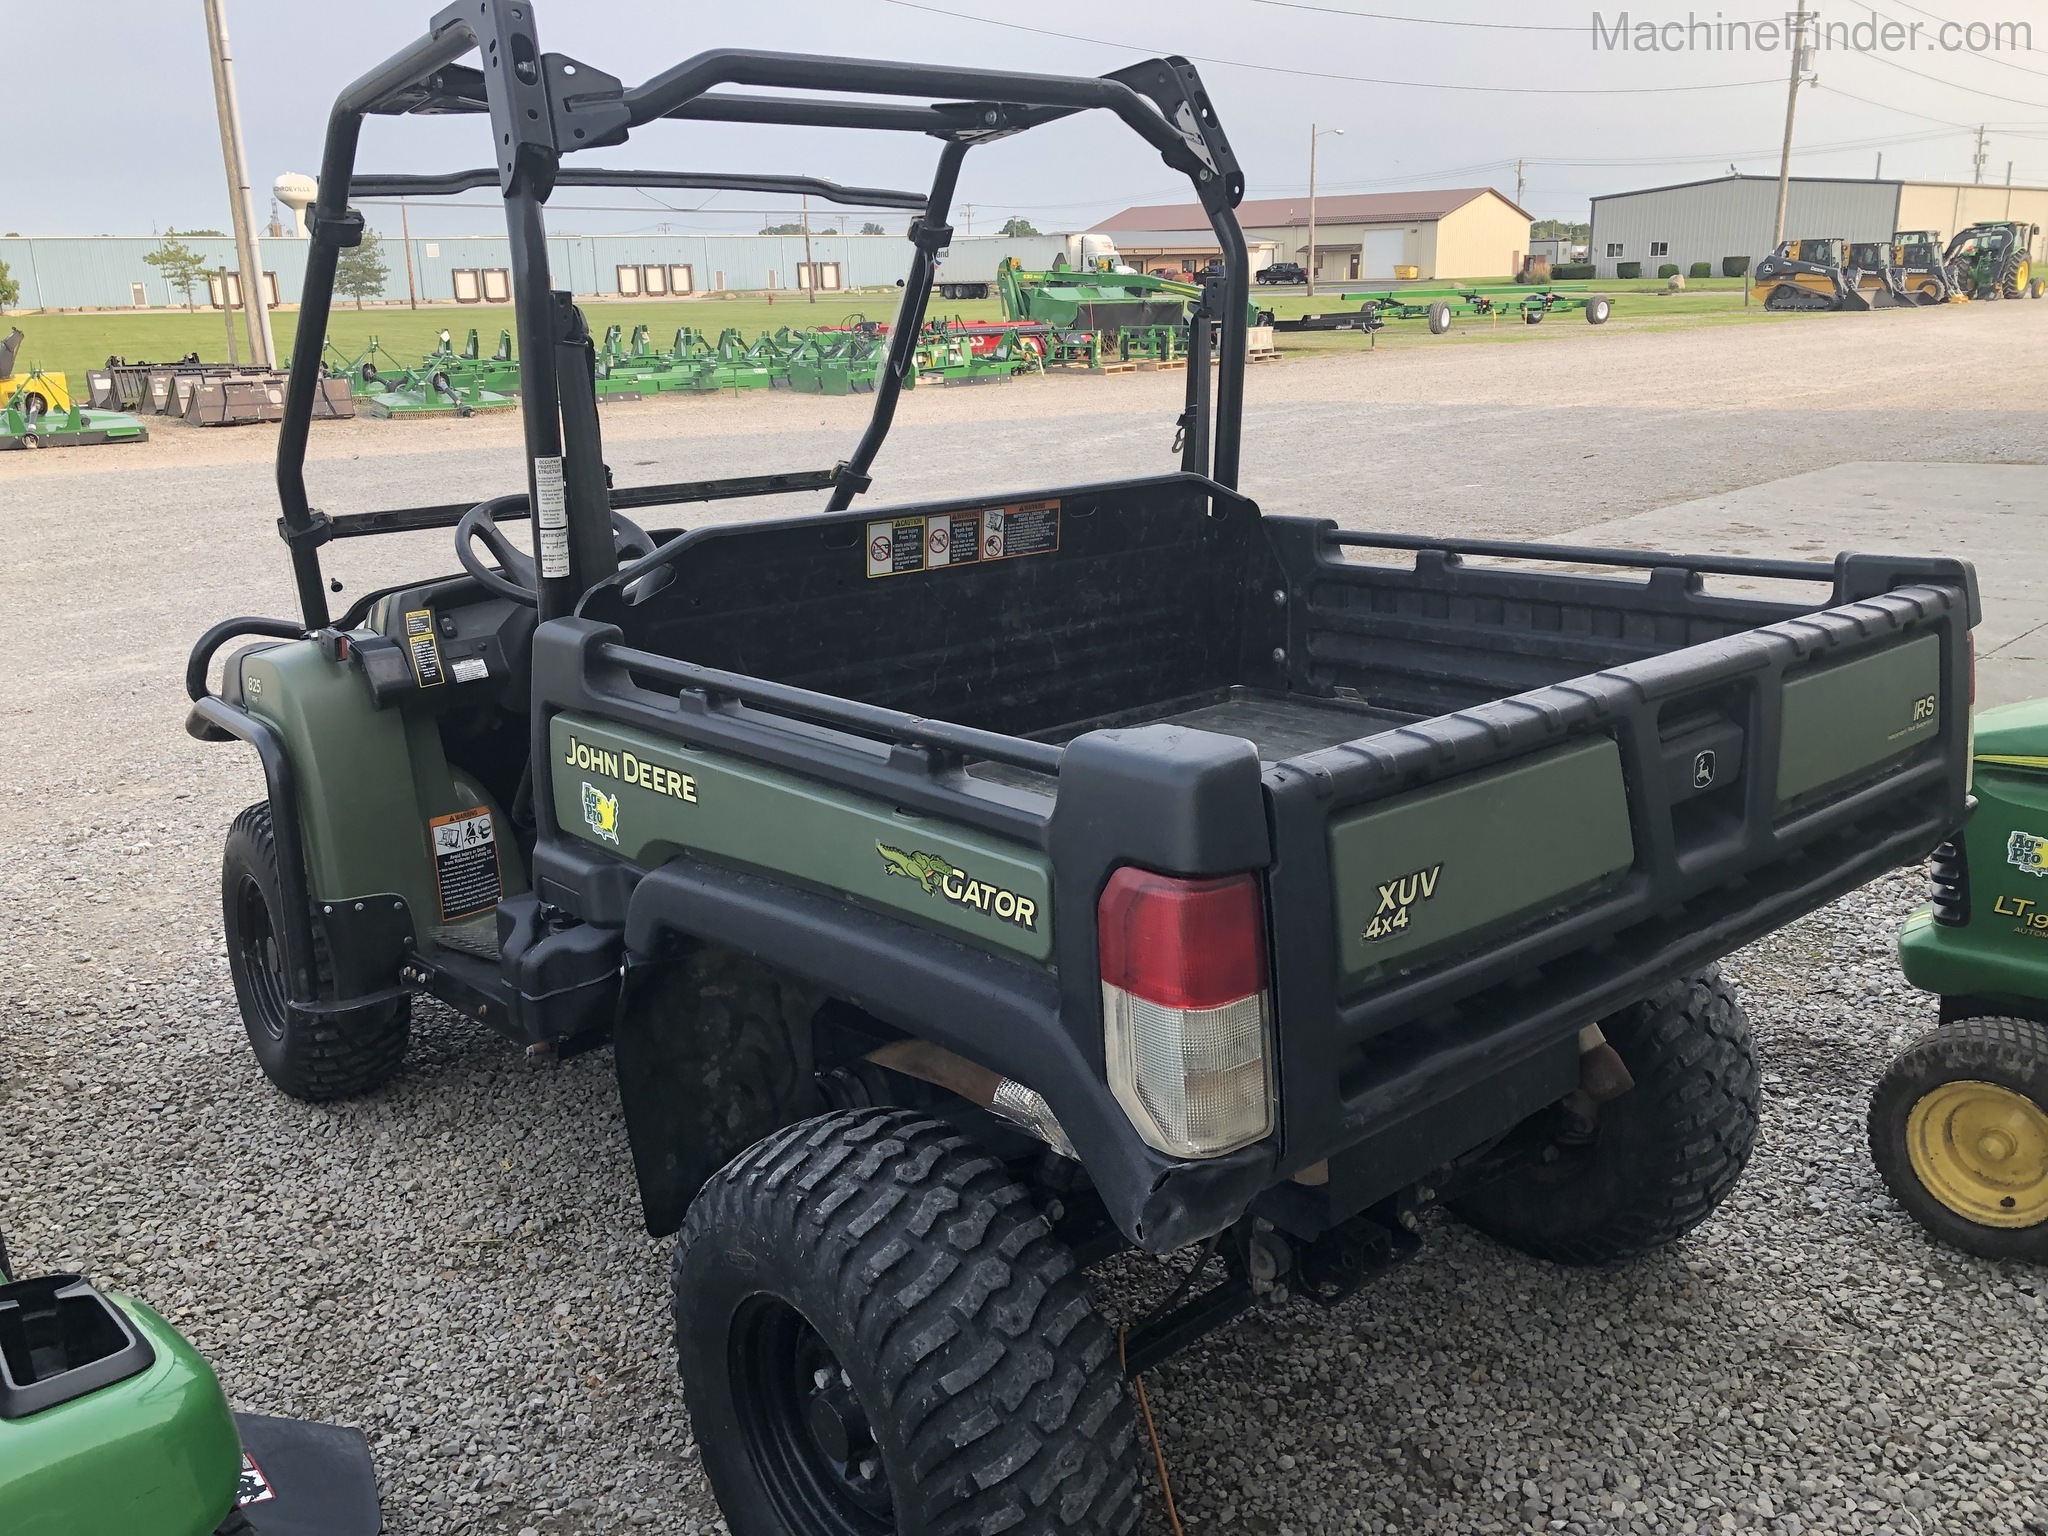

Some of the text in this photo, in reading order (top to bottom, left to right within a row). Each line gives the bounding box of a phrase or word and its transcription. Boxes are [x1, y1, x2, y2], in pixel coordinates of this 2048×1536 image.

[900, 518, 923, 526] CAUTION
[1913, 695, 1935, 721] IRS
[565, 735, 698, 804] JOHN DEERE
[587, 803, 603, 824] Pro
[2011, 847, 2042, 863] Pro
[2012, 833, 2042, 852] Ag-
[941, 868, 1036, 928] GATOR
[1376, 865, 1441, 915] XUV
[1364, 906, 1409, 938] 4x4
